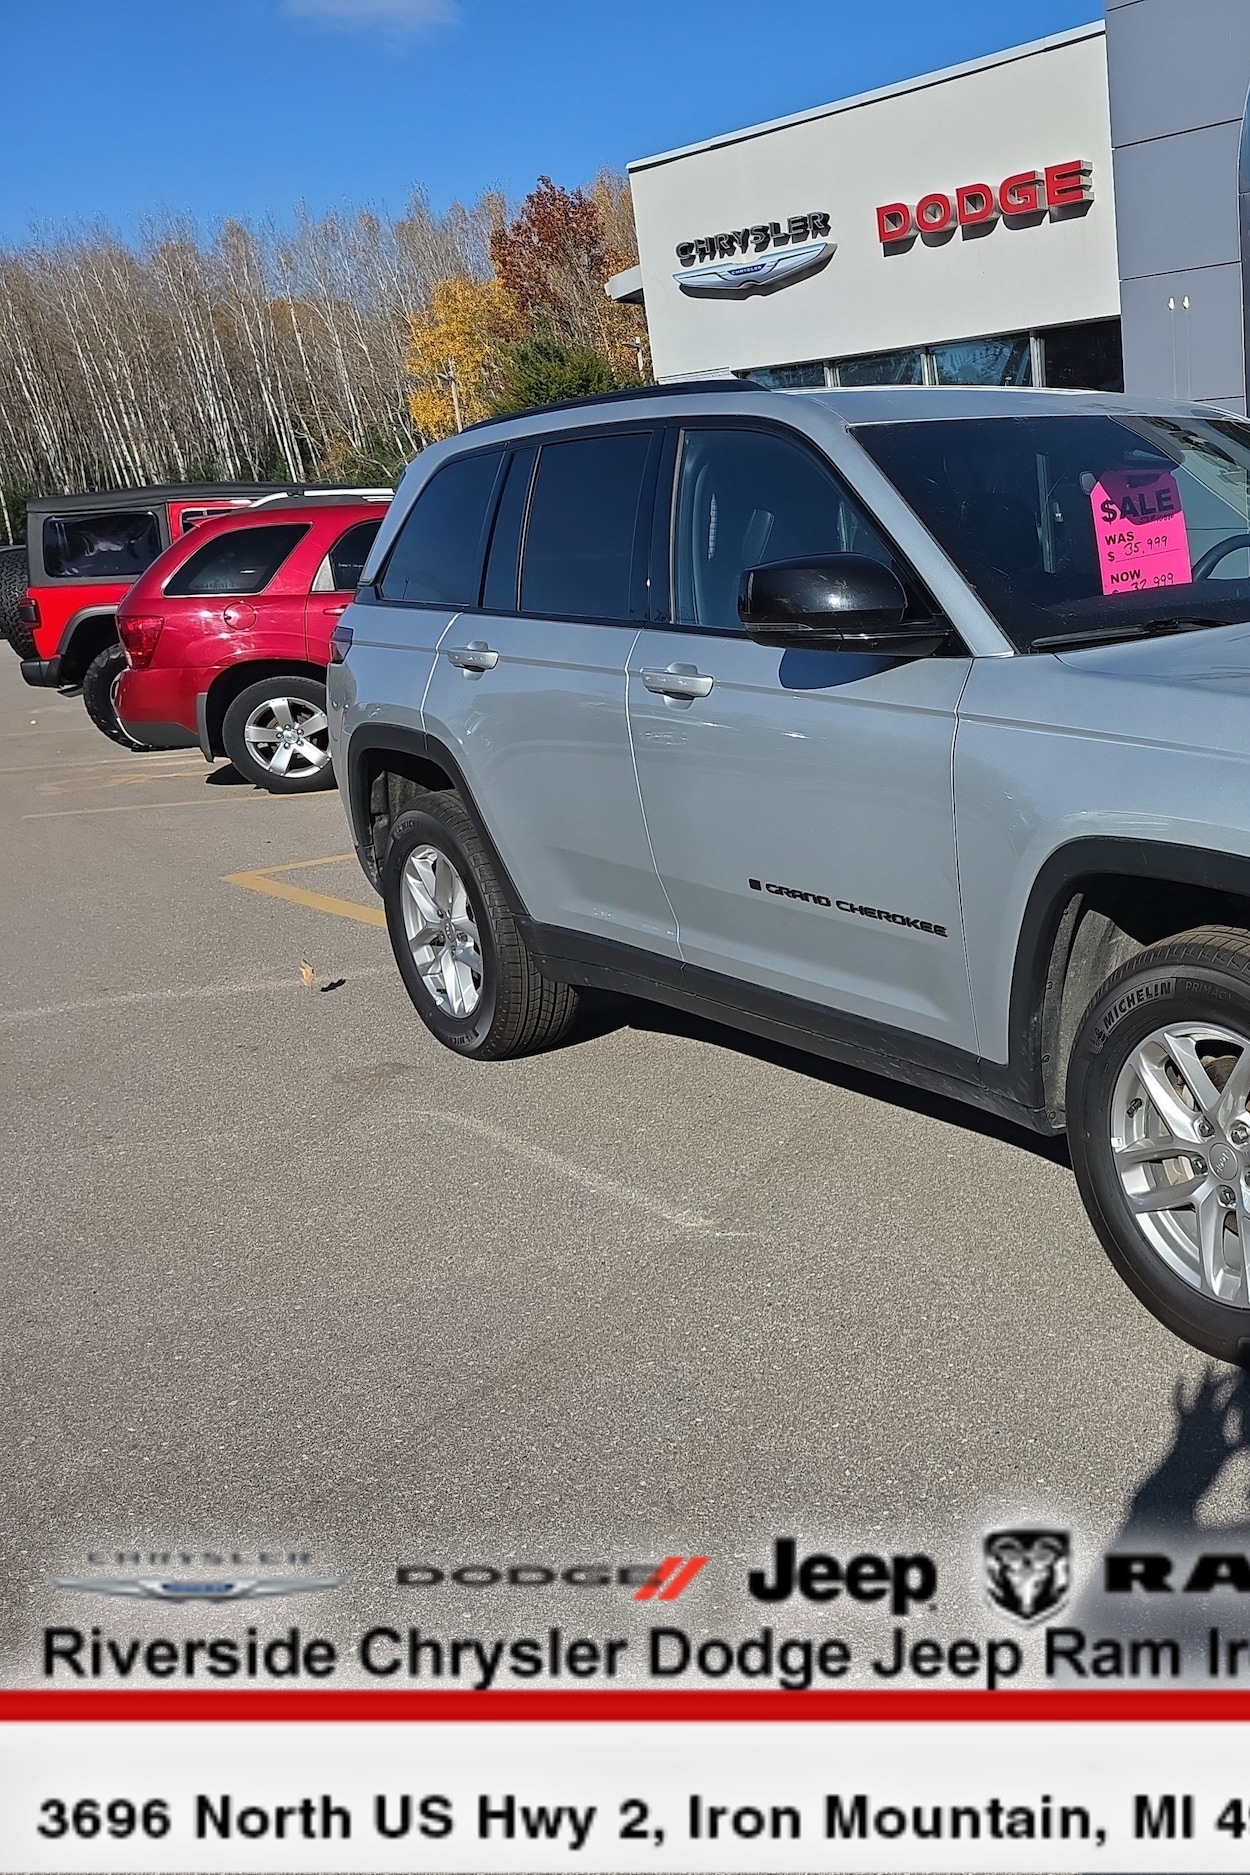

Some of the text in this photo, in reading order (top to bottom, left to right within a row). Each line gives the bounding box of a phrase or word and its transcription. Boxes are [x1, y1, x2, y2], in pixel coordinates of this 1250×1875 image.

[876, 160, 1092, 244] DODGE
[676, 212, 830, 262] CHRYSLER
[731, 265, 762, 276] CHRYSLER
[1105, 531, 1135, 547] WAS
[1110, 569, 1141, 584] NOW
[765, 883, 948, 938] GRAND CHEROKEE
[1102, 982, 1172, 1031] MICHELIN
